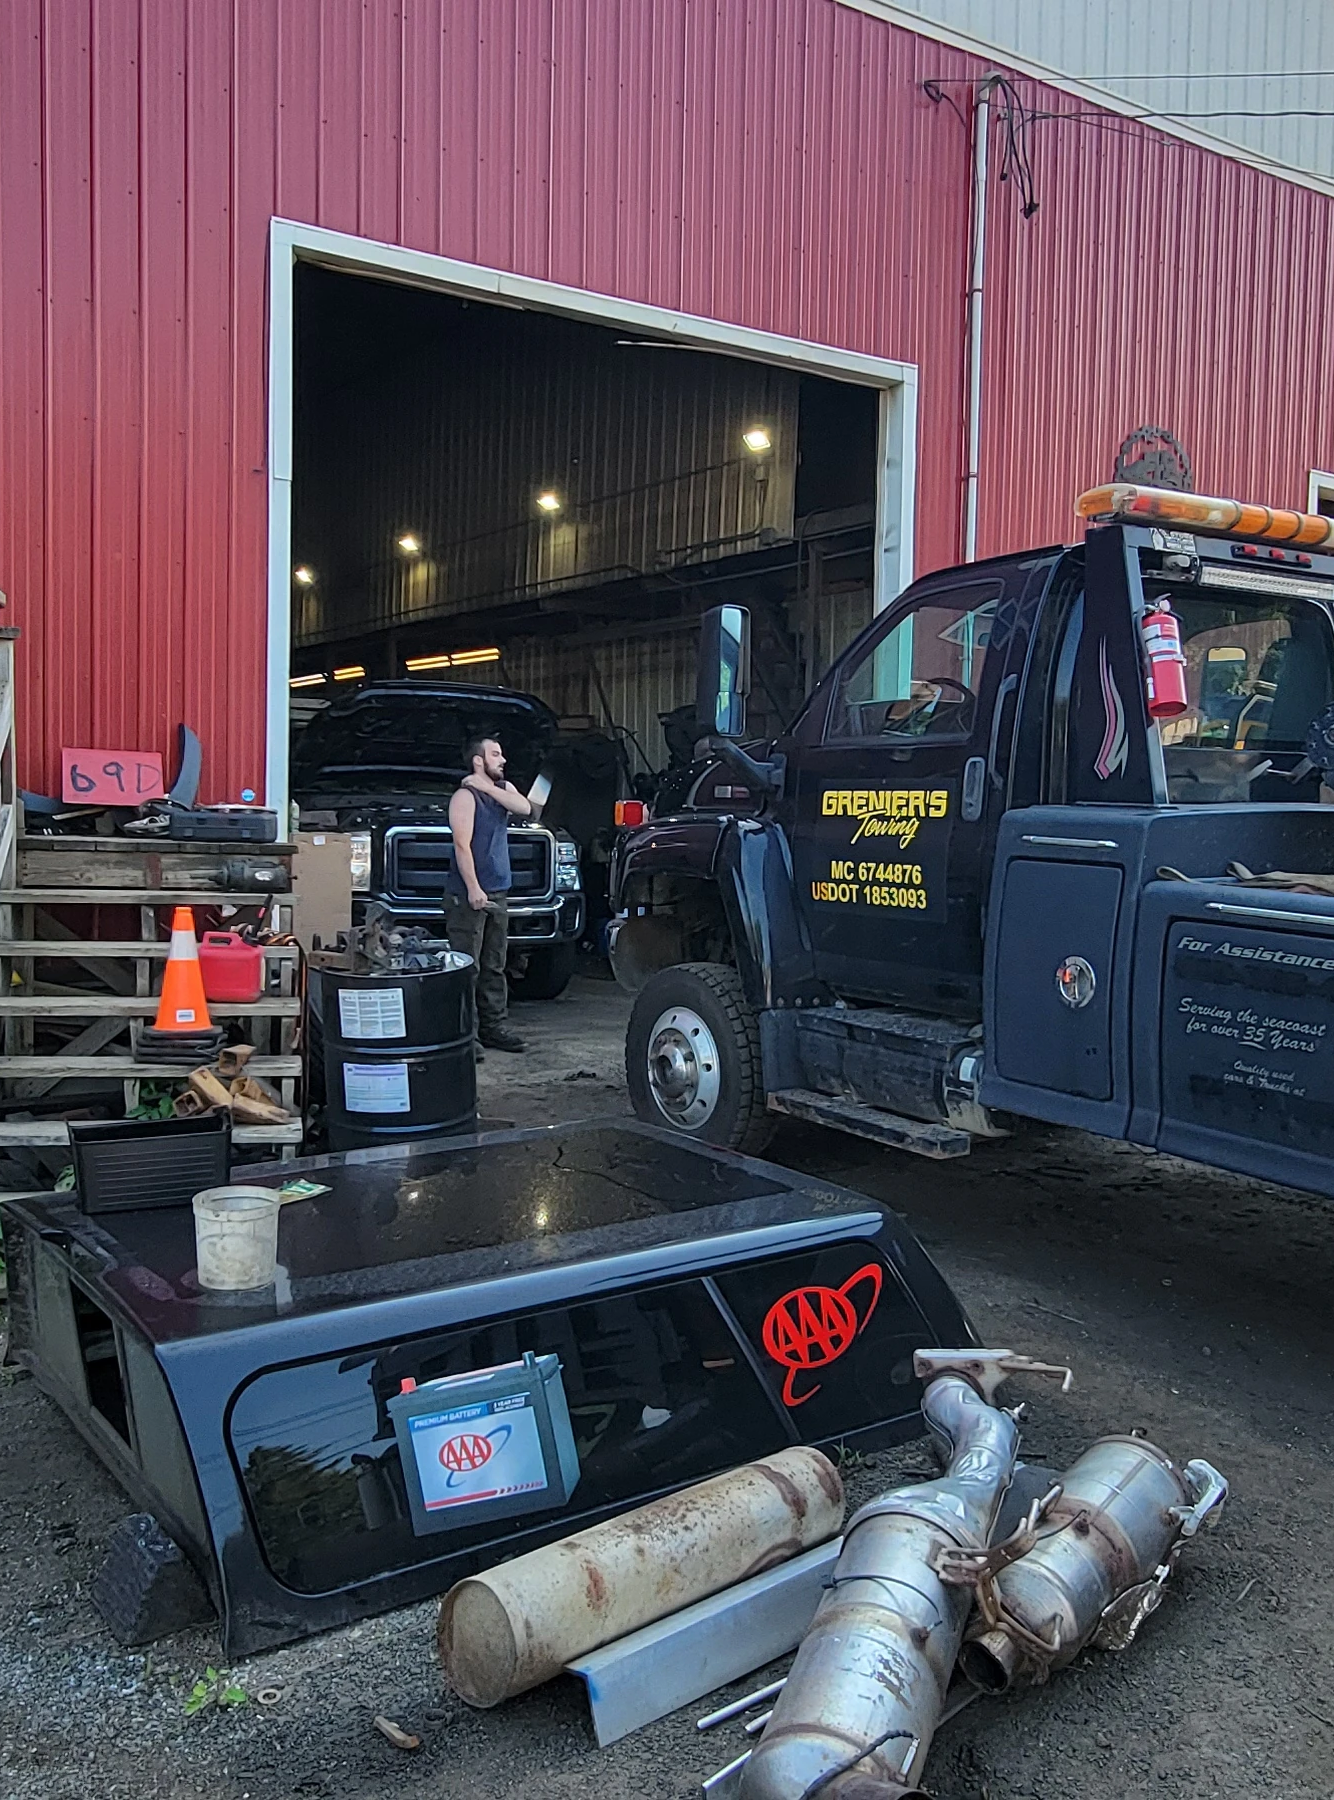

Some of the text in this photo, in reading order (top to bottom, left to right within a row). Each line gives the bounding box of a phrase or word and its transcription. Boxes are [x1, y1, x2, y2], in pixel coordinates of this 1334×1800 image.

[821, 790, 948, 818] GRENIER'S
[850, 810, 920, 849] Towing
[831, 860, 922, 885] MC 6744876
[811, 881, 927, 909] USDOT 1853093
[1177, 936, 1212, 952] For
[1178, 997, 1327, 1037] Serving the seacoast
[1185, 1016, 1316, 1052] for over 35 Years
[1233, 1060, 1269, 1078] Quality
[1246, 1074, 1254, 1085] &
[763, 1286, 857, 1368] AAA
[414, 1414, 449, 1429] PREMIUM
[449, 1407, 482, 1423] BATTERY
[440, 1434, 491, 1471] AAA
